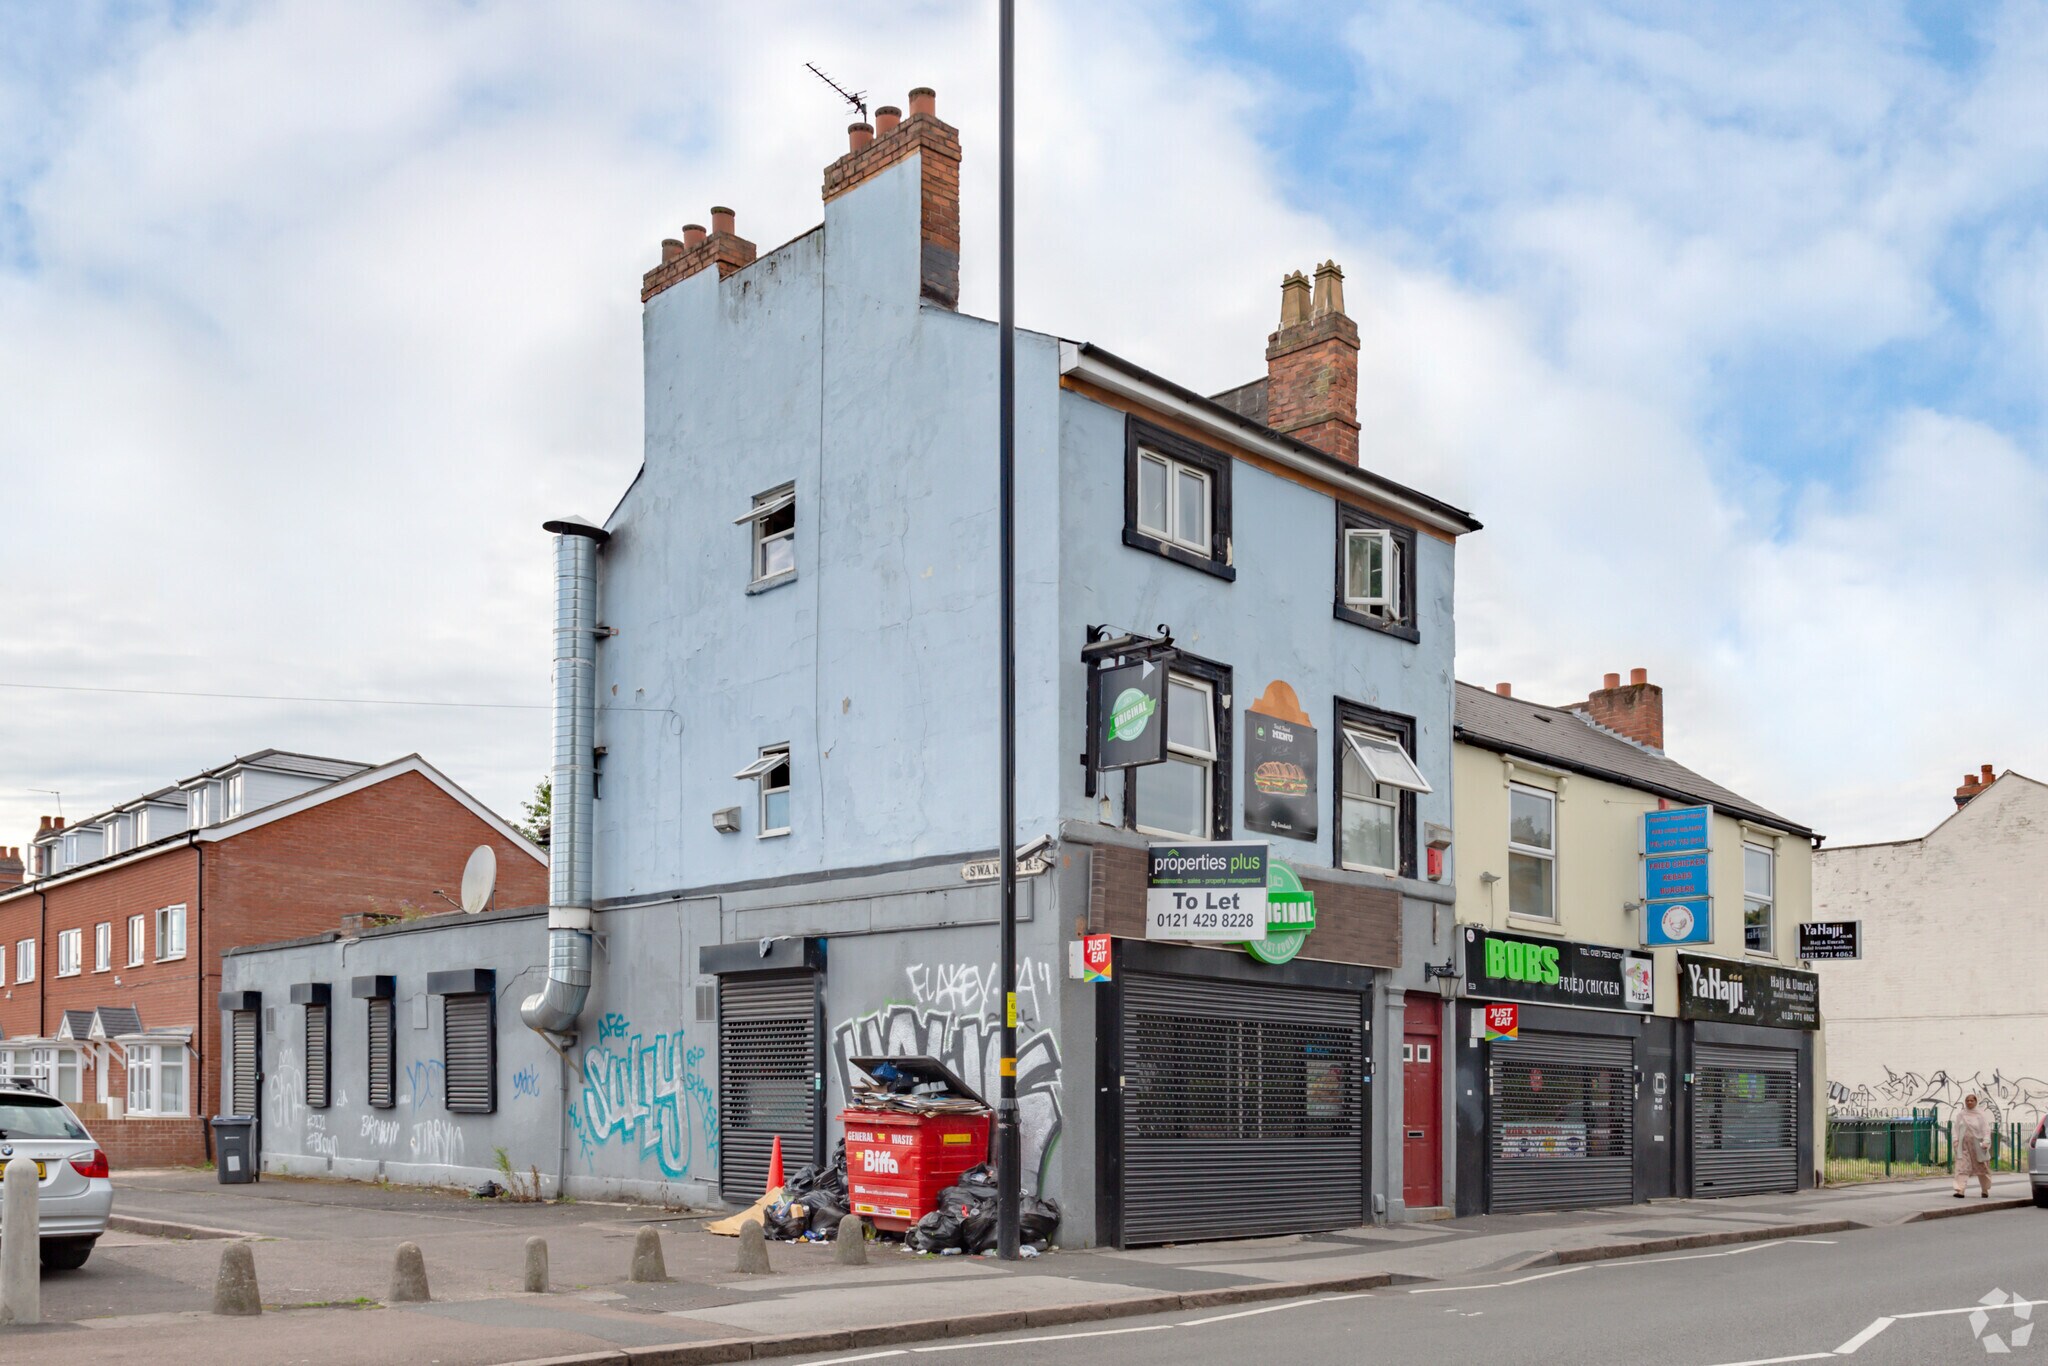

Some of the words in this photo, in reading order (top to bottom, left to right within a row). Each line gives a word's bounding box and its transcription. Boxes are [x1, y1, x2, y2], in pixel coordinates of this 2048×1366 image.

[1114, 701, 1148, 727] ORIGINAL
[1272, 730, 1293, 742] MENU
[1154, 853, 1227, 875] properties
[1230, 853, 1261, 874] plus
[1649, 861, 1670, 870] FRIED
[1672, 858, 1705, 868] CHICKEN
[1663, 872, 1692, 881] KEBABS
[1660, 884, 1694, 895] BURGERS
[1172, 892, 1198, 910] To
[1205, 892, 1240, 910] Let
[1157, 913, 1188, 928] 0121
[1193, 913, 1217, 928] 429
[1221, 913, 1254, 928] 8228
[1803, 923, 1844, 939] YaHajji
[1087, 939, 1107, 954] JUST
[1091, 950, 1107, 963] EAT
[1485, 937, 1560, 985] BOBS
[1559, 976, 1584, 994] FRIED
[1586, 979, 1620, 996] CHICKEN
[1687, 963, 1743, 1013] YaHajji
[1770, 975, 1785, 991] Hajj
[1785, 978, 1791, 989] &
[1792, 978, 1814, 992] Umrah
[1632, 990, 1650, 1000] PIZZA
[1490, 1008, 1512, 1019] JUST
[1494, 1017, 1512, 1027] EAT
[847, 1131, 875, 1143] GENERAL
[891, 1134, 913, 1146] WASTE
[864, 1149, 899, 1175] Biffa
[854, 1185, 866, 1194] Biffa
